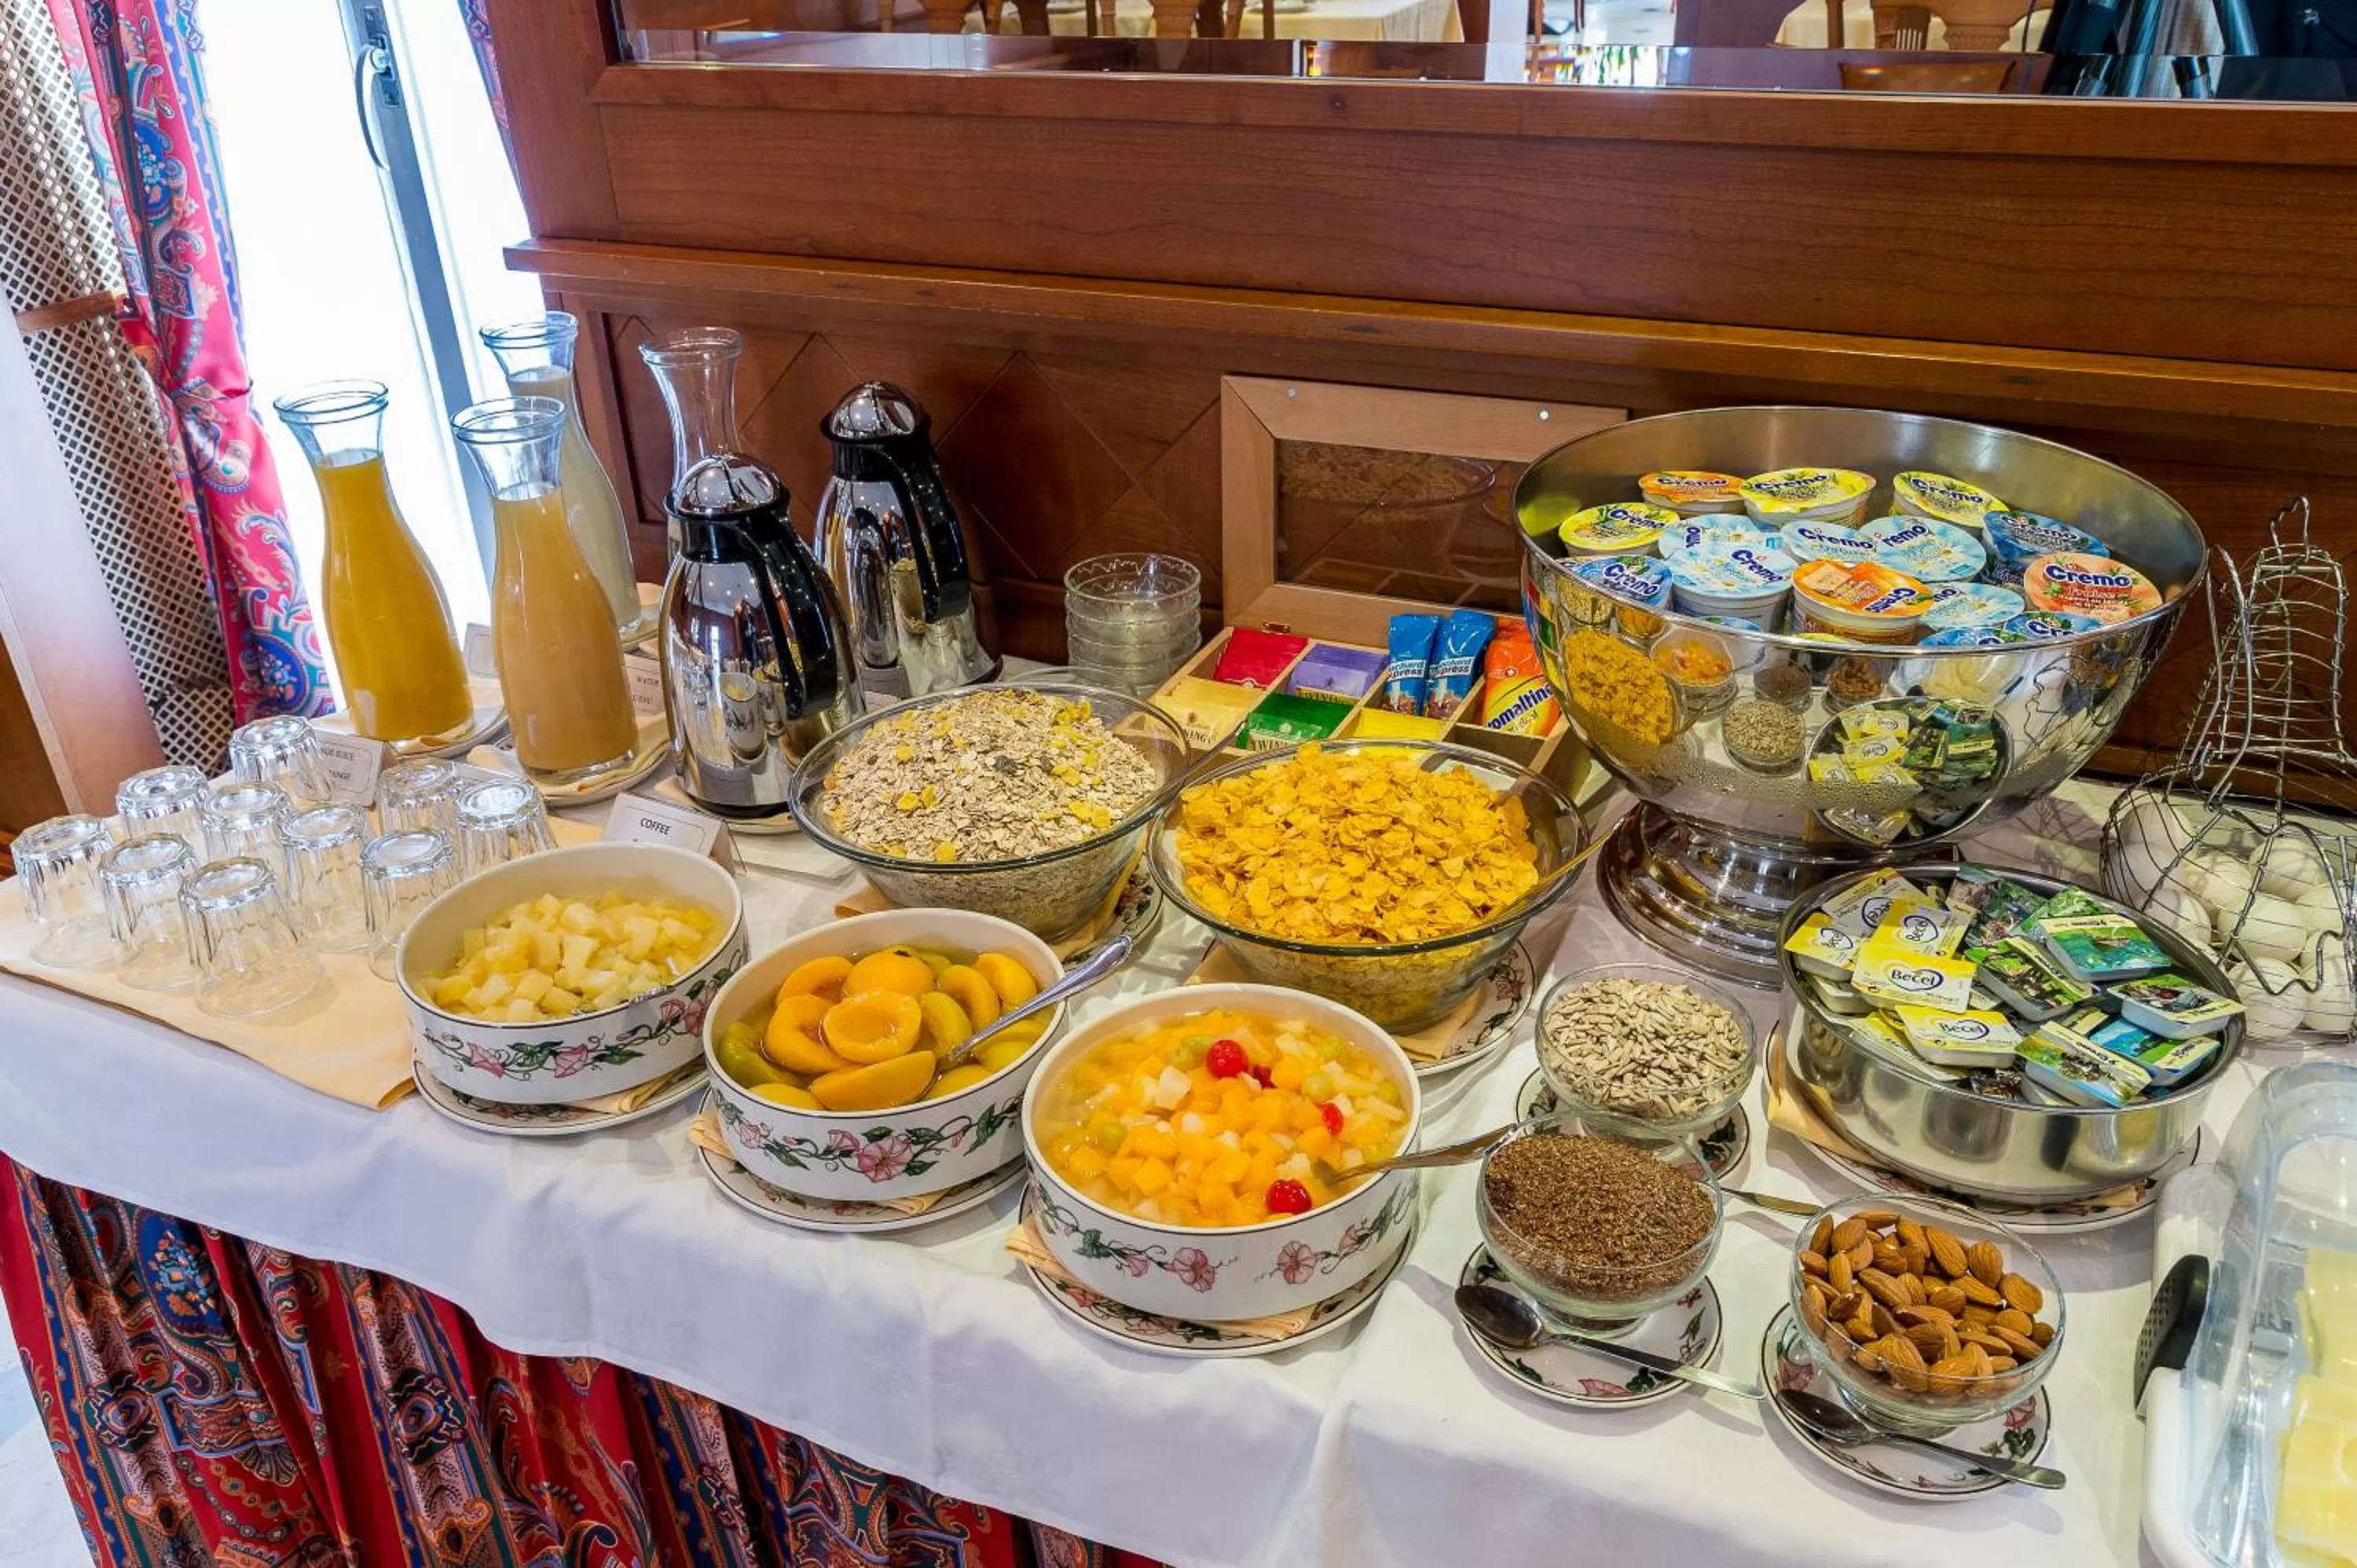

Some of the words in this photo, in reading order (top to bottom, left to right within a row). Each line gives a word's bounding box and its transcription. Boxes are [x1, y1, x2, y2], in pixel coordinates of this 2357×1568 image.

[1754, 474, 1827, 489] Cremo
[1912, 478, 1984, 503] Cremo
[1609, 509, 1666, 529] Cremo
[1797, 527, 1874, 549] Cremo
[1882, 524, 1926, 548] remo
[1731, 549, 1785, 582] Cremo
[2044, 564, 2132, 587] Cremo
[1604, 564, 1659, 595] Cremo
[1865, 588, 1916, 613] Cremo
[1487, 683, 1553, 729] omaltin
[640, 818, 672, 835] COFFEE
[1867, 899, 1893, 924] ecel
[1891, 969, 1935, 986] Becel
[1938, 1021, 1985, 1035] Becel
